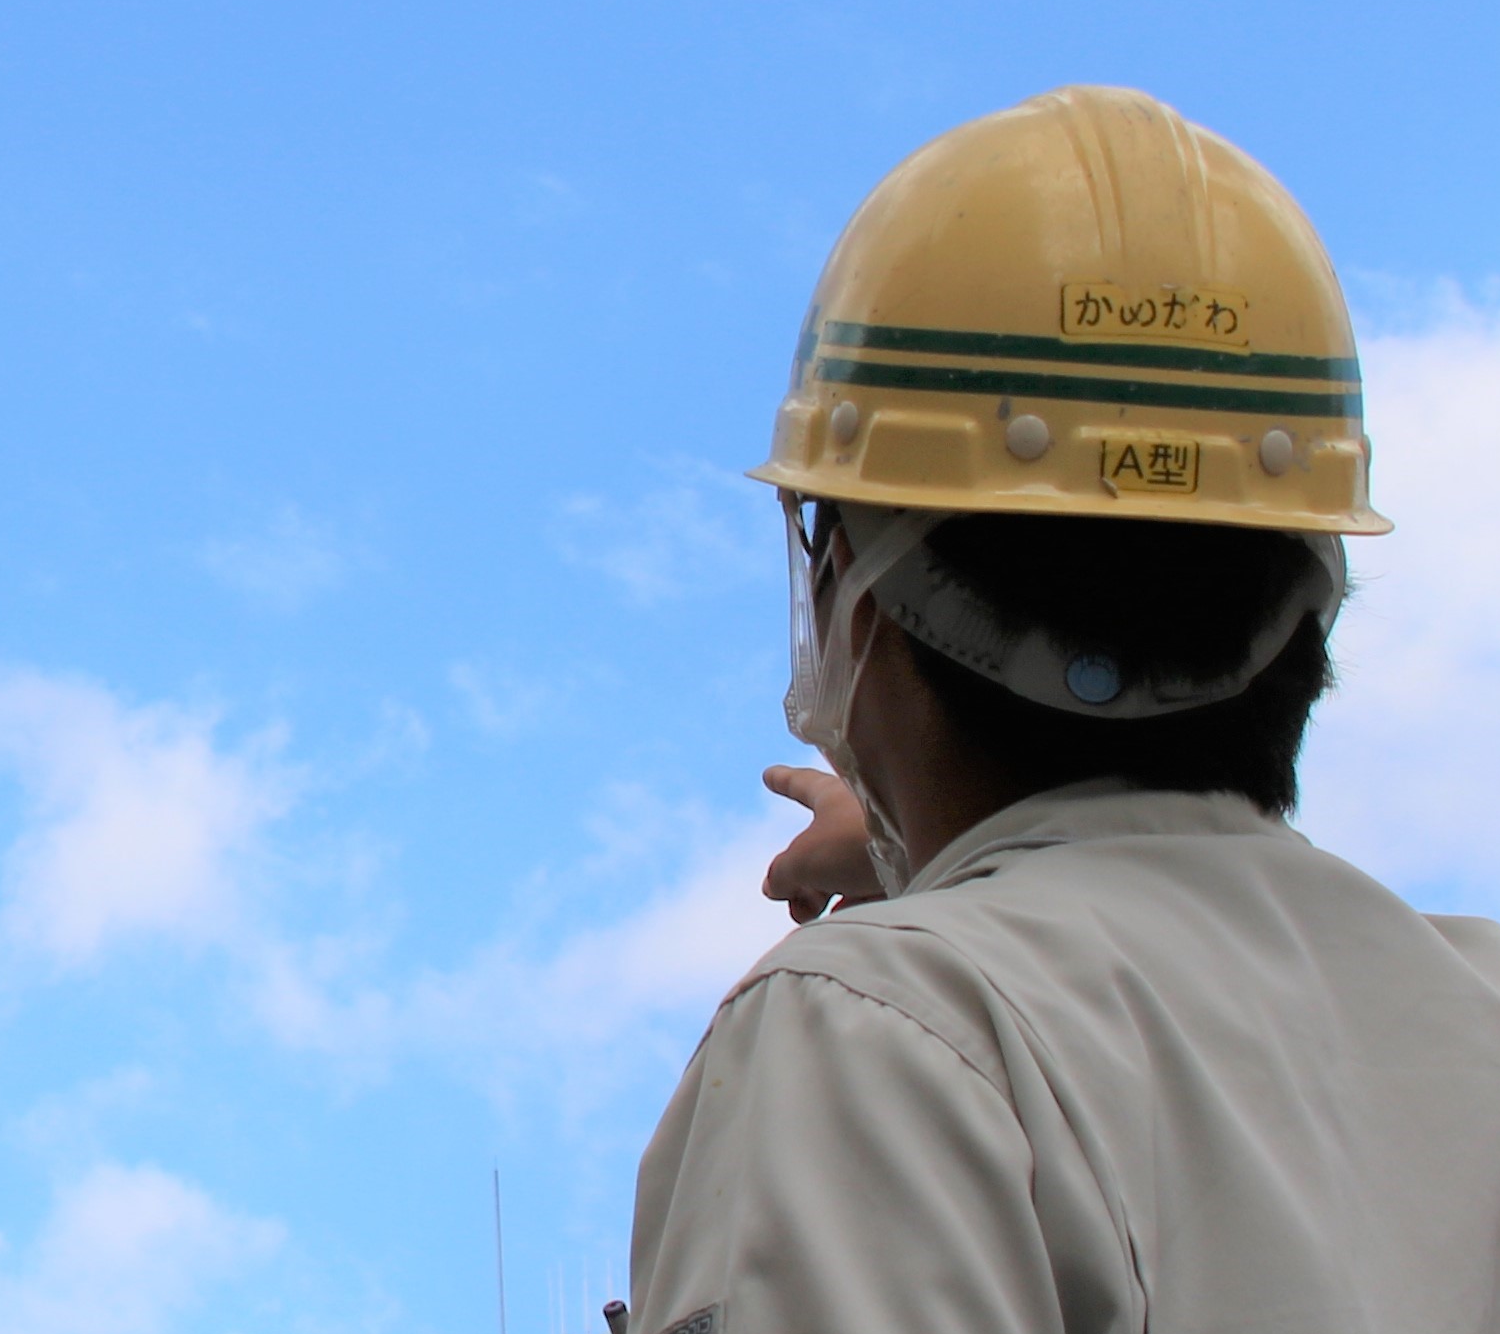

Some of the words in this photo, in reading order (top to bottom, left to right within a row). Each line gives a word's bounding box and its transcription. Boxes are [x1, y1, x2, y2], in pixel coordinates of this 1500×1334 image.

[1074, 290, 1238, 335] かめがわ
[1111, 443, 1187, 487] A型
